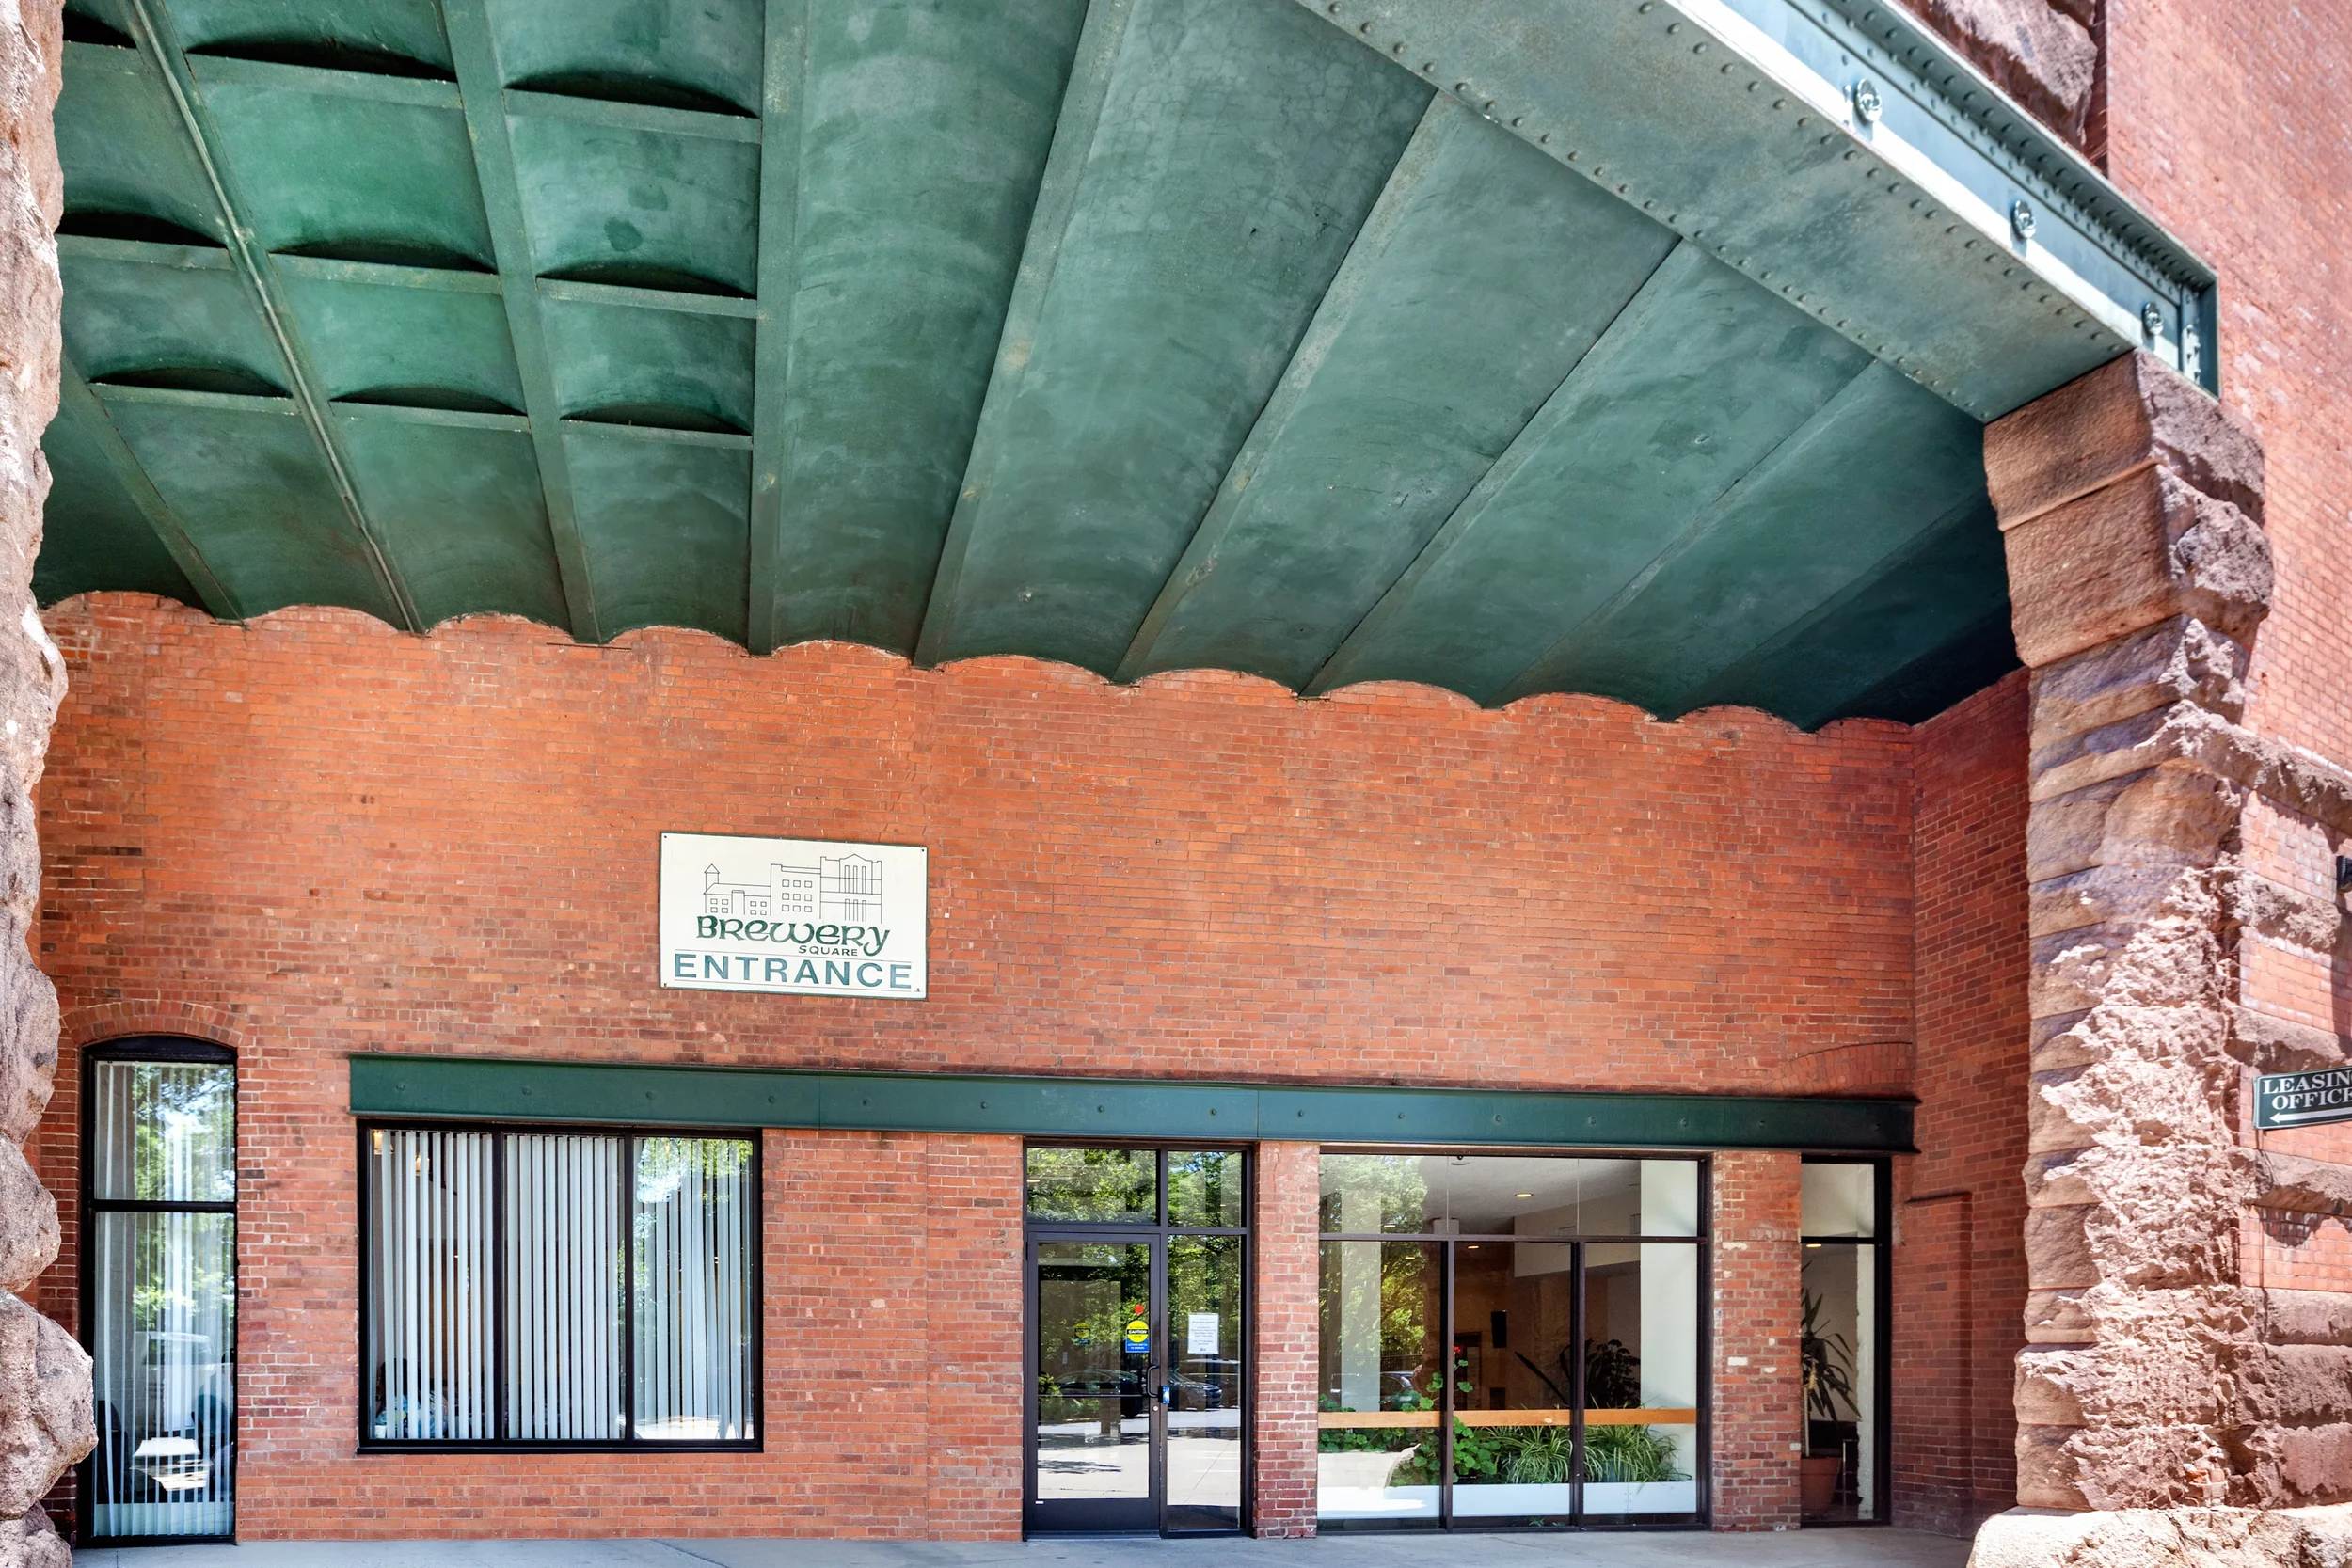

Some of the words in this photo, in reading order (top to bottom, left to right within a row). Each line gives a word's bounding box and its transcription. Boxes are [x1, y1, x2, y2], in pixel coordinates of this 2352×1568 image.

[798, 945, 858, 957] SQUARE
[675, 953, 912, 989] ENTRANCE
[2264, 1070, 2352, 1094] LEASIN
